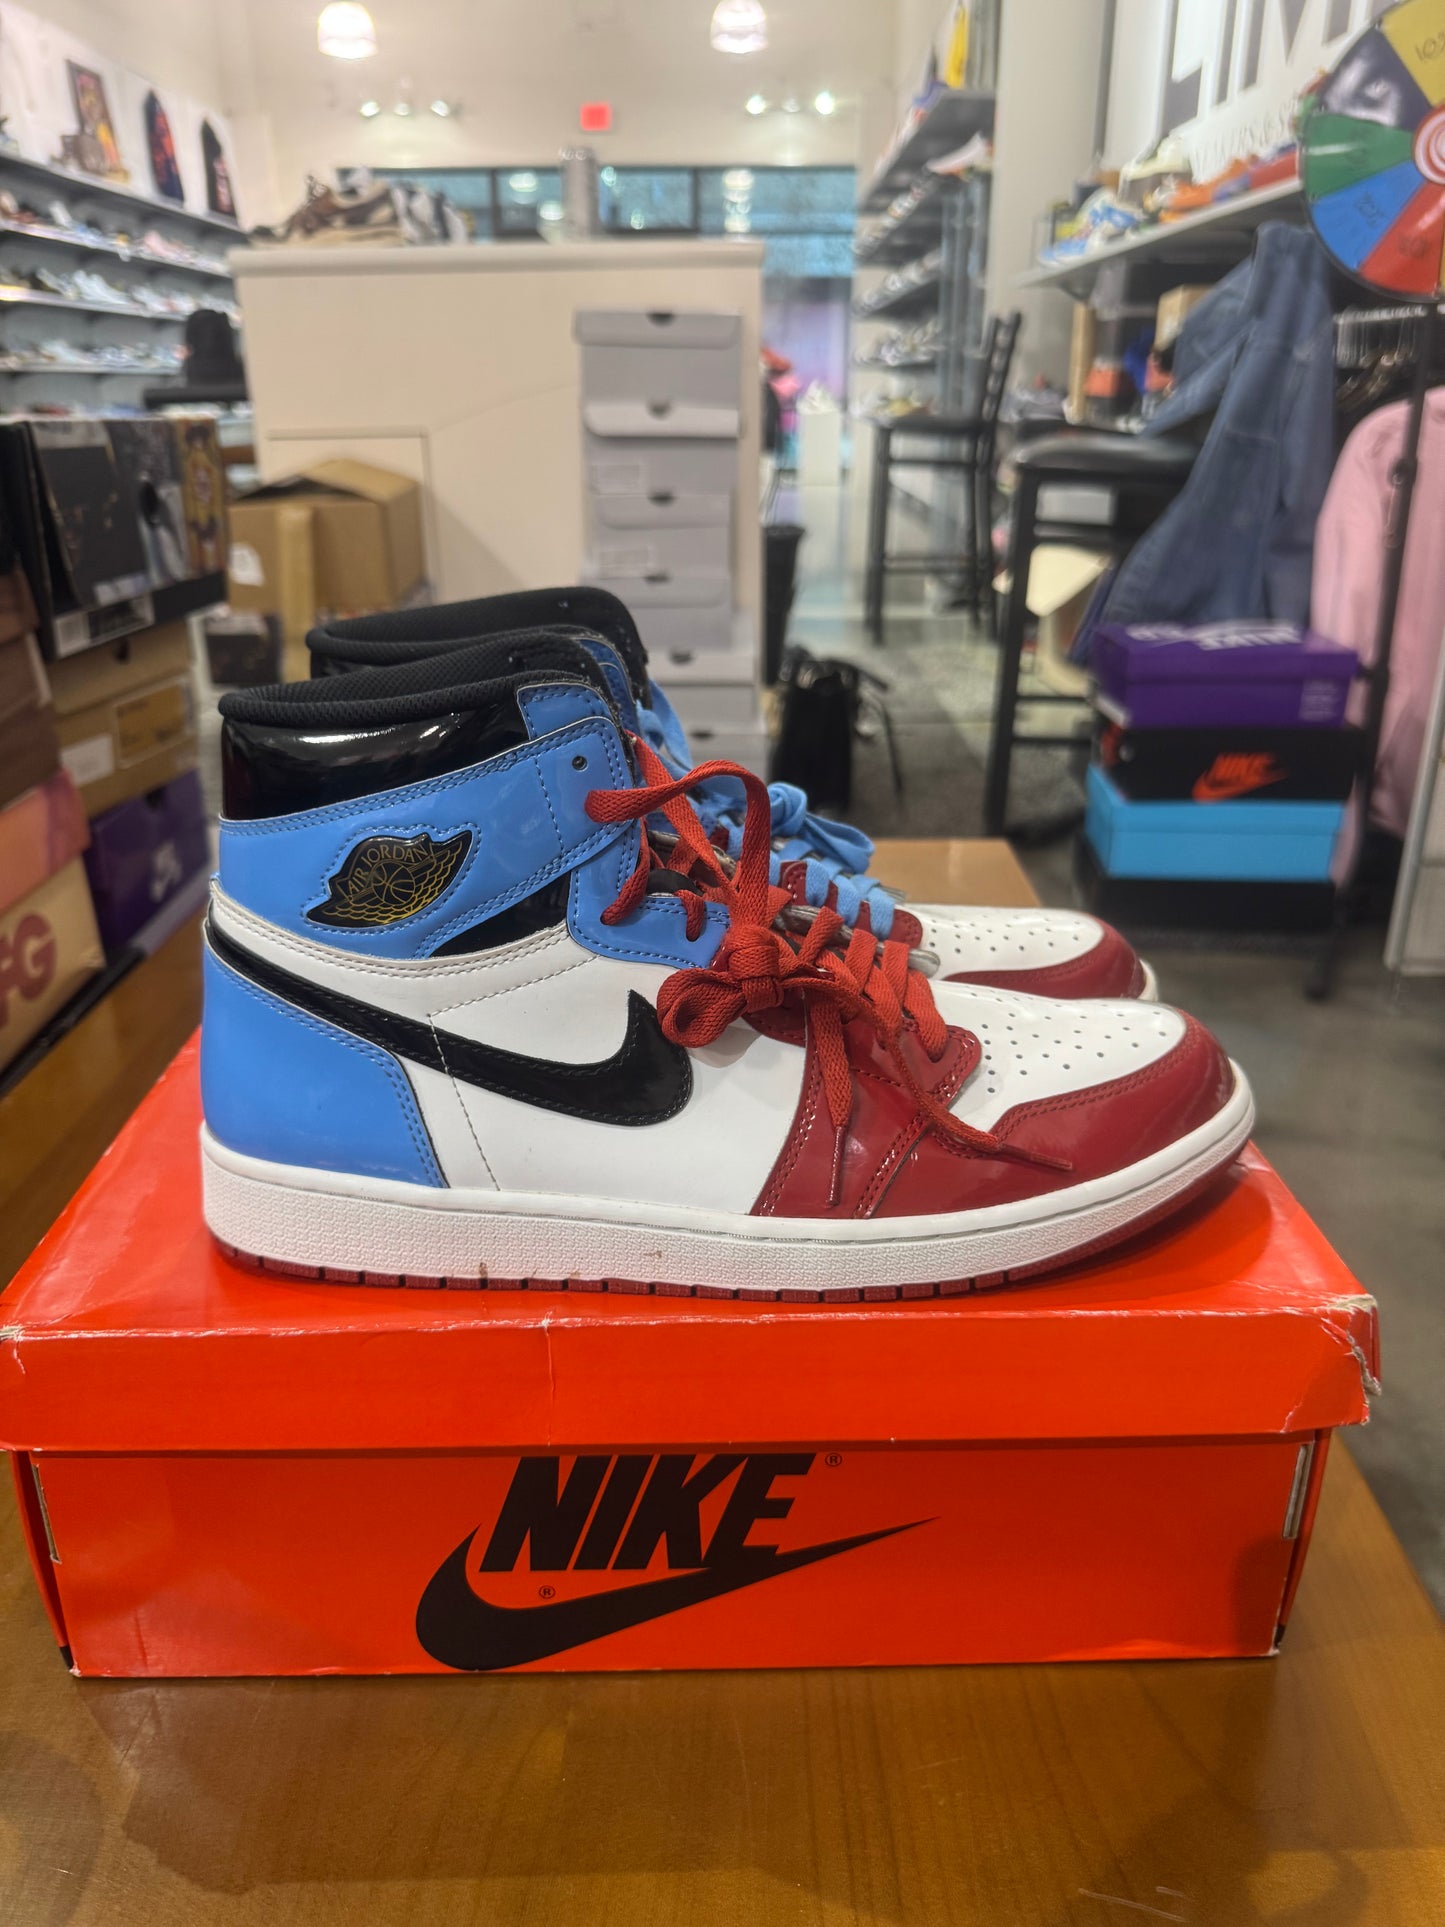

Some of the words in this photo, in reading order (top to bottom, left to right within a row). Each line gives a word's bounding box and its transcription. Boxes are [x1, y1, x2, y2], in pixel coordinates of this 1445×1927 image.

[348, 868, 370, 894] AIR
[361, 843, 428, 867] JORDAN
[478, 1452, 817, 1572] NIKE
